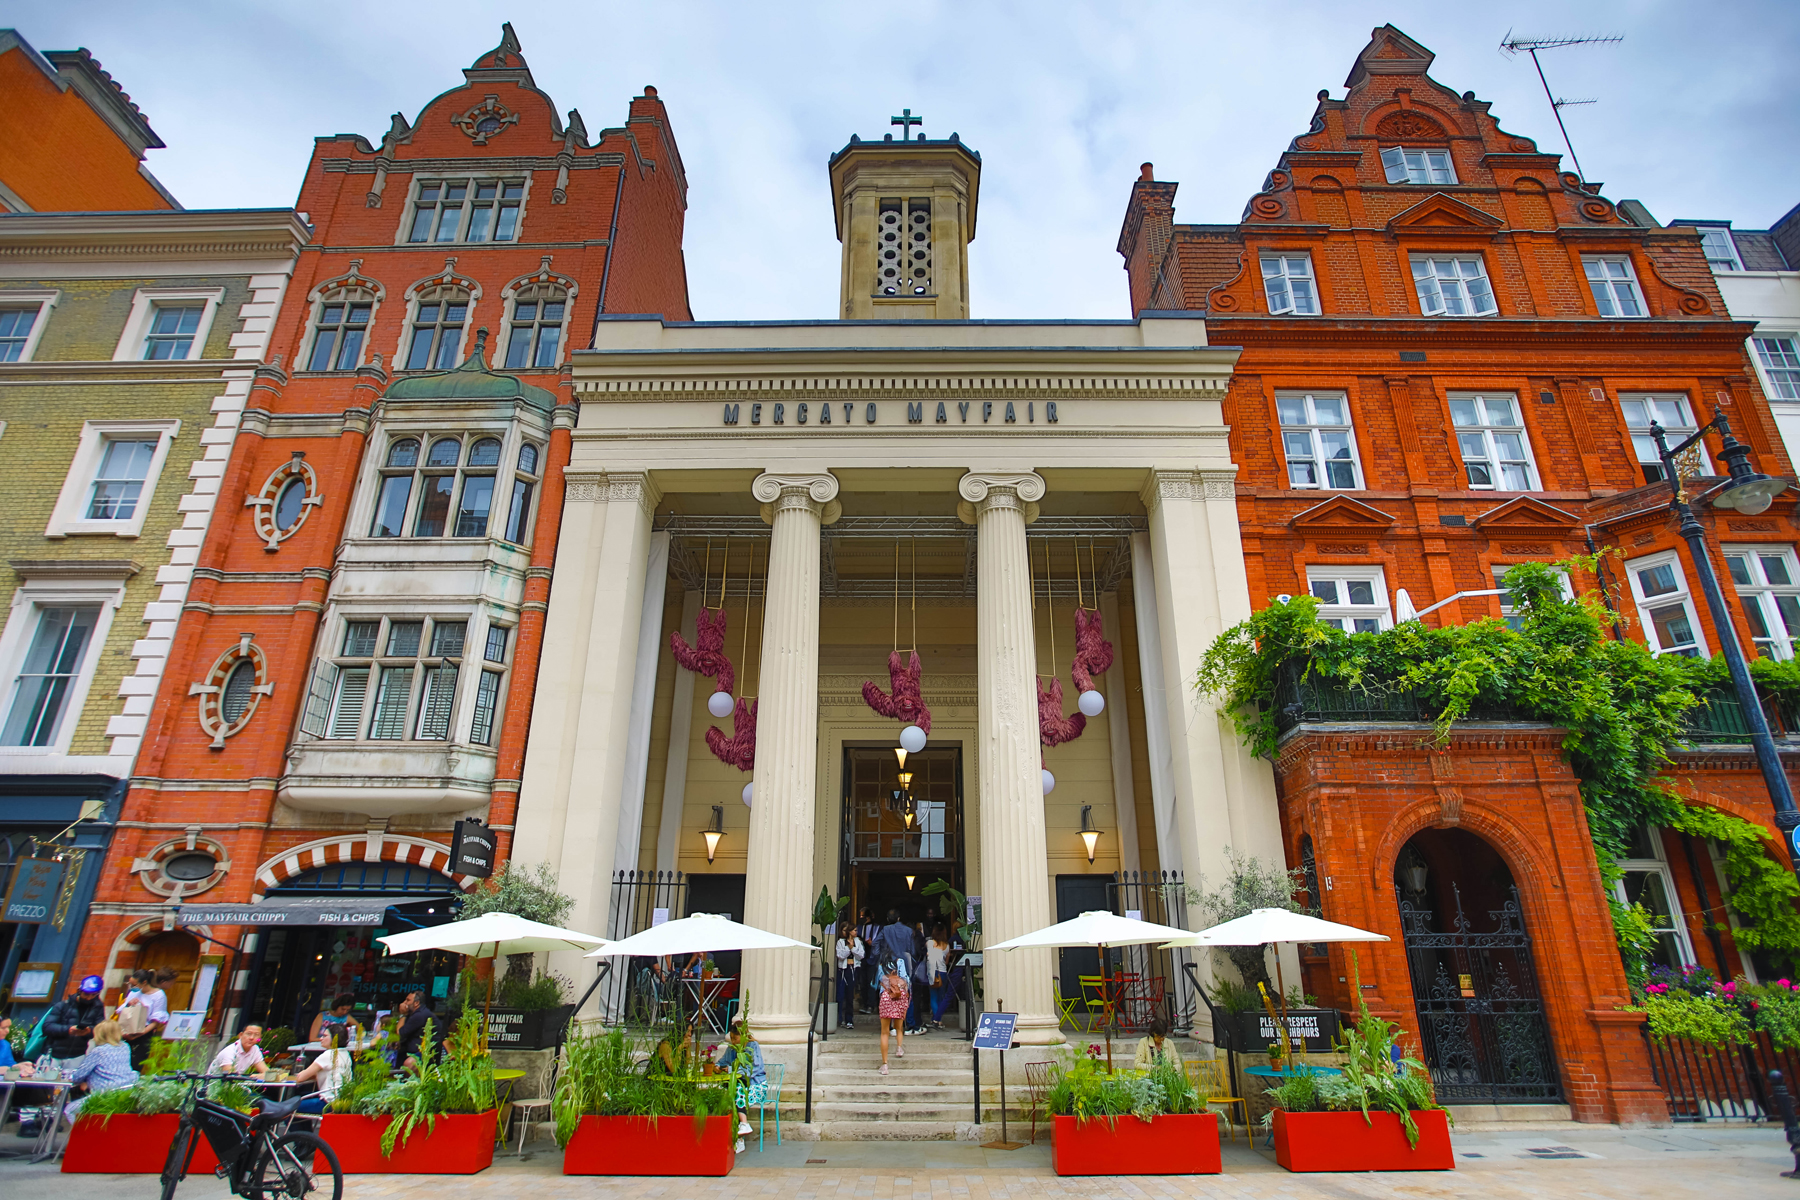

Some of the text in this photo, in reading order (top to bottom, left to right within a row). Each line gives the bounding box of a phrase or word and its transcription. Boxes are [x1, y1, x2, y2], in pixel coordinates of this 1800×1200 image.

[723, 401, 1059, 424] MERCATO MAYFAIR
[463, 855, 472, 864] FISH
[475, 858, 487, 867] CHIPS
[1325, 876, 1333, 891] 13
[7, 904, 46, 918] PREZZO
[182, 912, 380, 922] THE MAYFAIR CHIPPY FISH & CHIPS
[352, 982, 426, 993] FISH & CHIPS
[488, 1013, 495, 1023] TO
[495, 1013, 524, 1024] MAYFAIR
[1287, 1017, 1318, 1027] RESPECT
[488, 1024, 508, 1033] MARK
[1260, 1027, 1275, 1038] OUR
[501, 1033, 521, 1042] STREET
